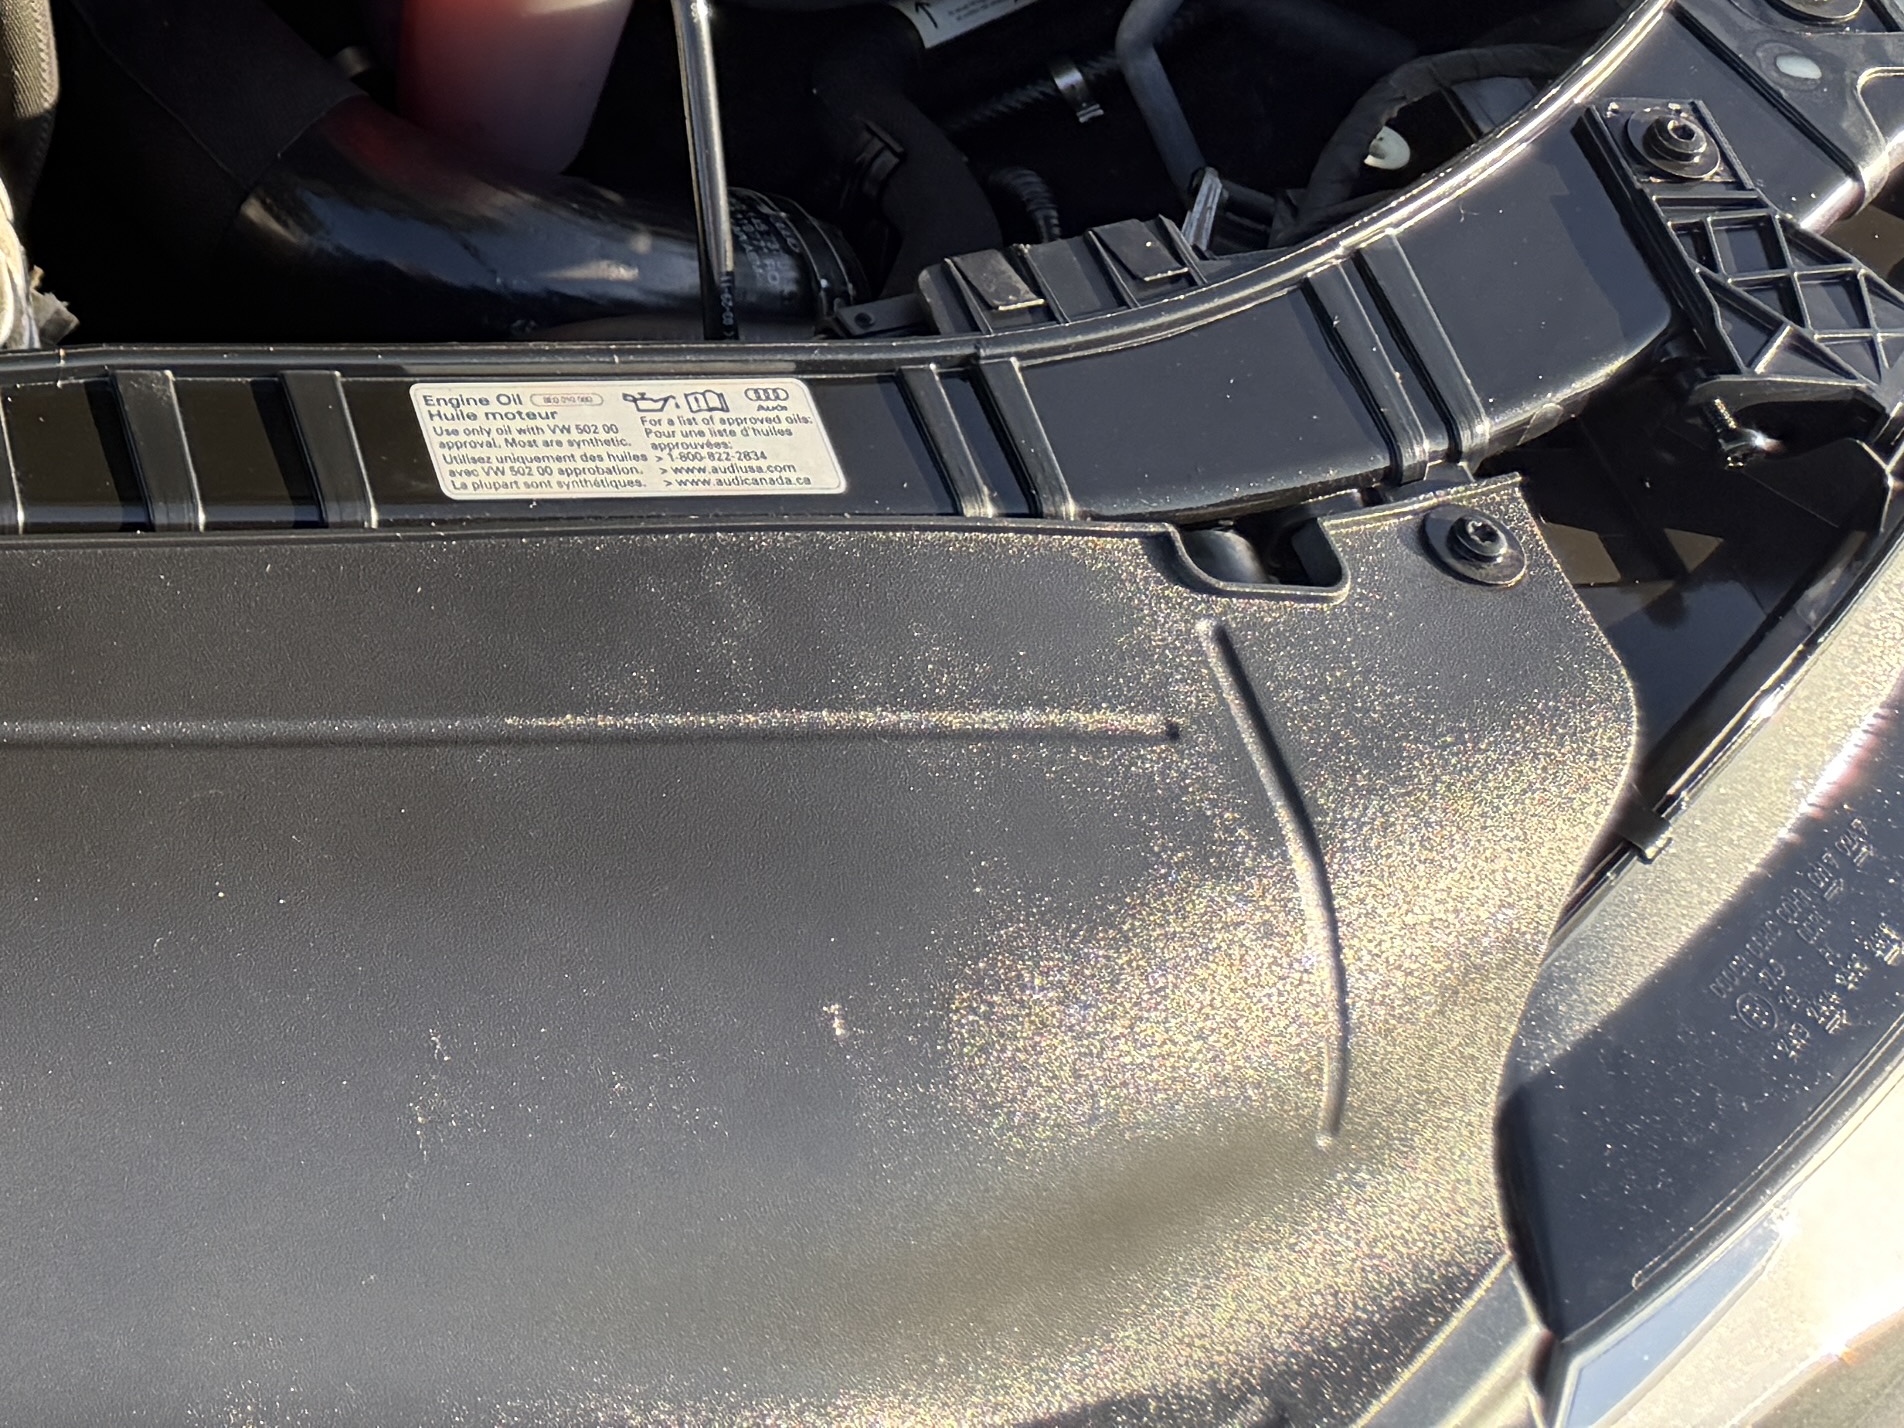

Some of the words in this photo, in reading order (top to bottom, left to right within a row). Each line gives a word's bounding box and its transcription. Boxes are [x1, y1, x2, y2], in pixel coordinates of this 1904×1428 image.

[422, 393, 491, 409] Engine
[495, 393, 523, 406] Oil
[428, 408, 478, 421] Huile
[484, 410, 558, 421] moteur
[640, 415, 662, 426] For
[667, 417, 675, 426] a
[677, 415, 698, 426] list
[701, 414, 715, 425] of
[719, 414, 782, 427] approved
[785, 413, 813, 424] oils:
[432, 425, 459, 436] Use
[463, 425, 492, 437] only
[495, 424, 512, 436] oil
[516, 424, 545, 436] with
[546, 423, 571, 434] VW
[575, 423, 599, 434] 502
[601, 423, 619, 434] 00
[644, 427, 676, 438] Pour
[680, 430, 706, 438] une
[708, 427, 737, 437] liste
[740, 425, 793, 437] d'huiles
[439, 437, 502, 451] approval.
[504, 437, 539, 448] Most
[542, 439, 563, 448] are
[566, 436, 632, 449] synthetic.
[650, 438, 733, 452] approuvées:
[442, 453, 492, 465] Utilisez
[495, 452, 577, 465] uniquement
[579, 451, 604, 463] des
[606, 450, 648, 463] huiles
[448, 468, 479, 477] avec
[481, 465, 505, 476] VW
[509, 465, 534, 476] 502
[536, 465, 553, 476] 00
[557, 464, 644, 478] approbation.
[670, 462, 797, 475] www.audiusa.com
[451, 479, 468, 490] La
[472, 479, 520, 491] plupart
[523, 479, 553, 489] sont
[555, 476, 647, 490] synthétiques.
[675, 475, 812, 487] www.audicanada.ca
